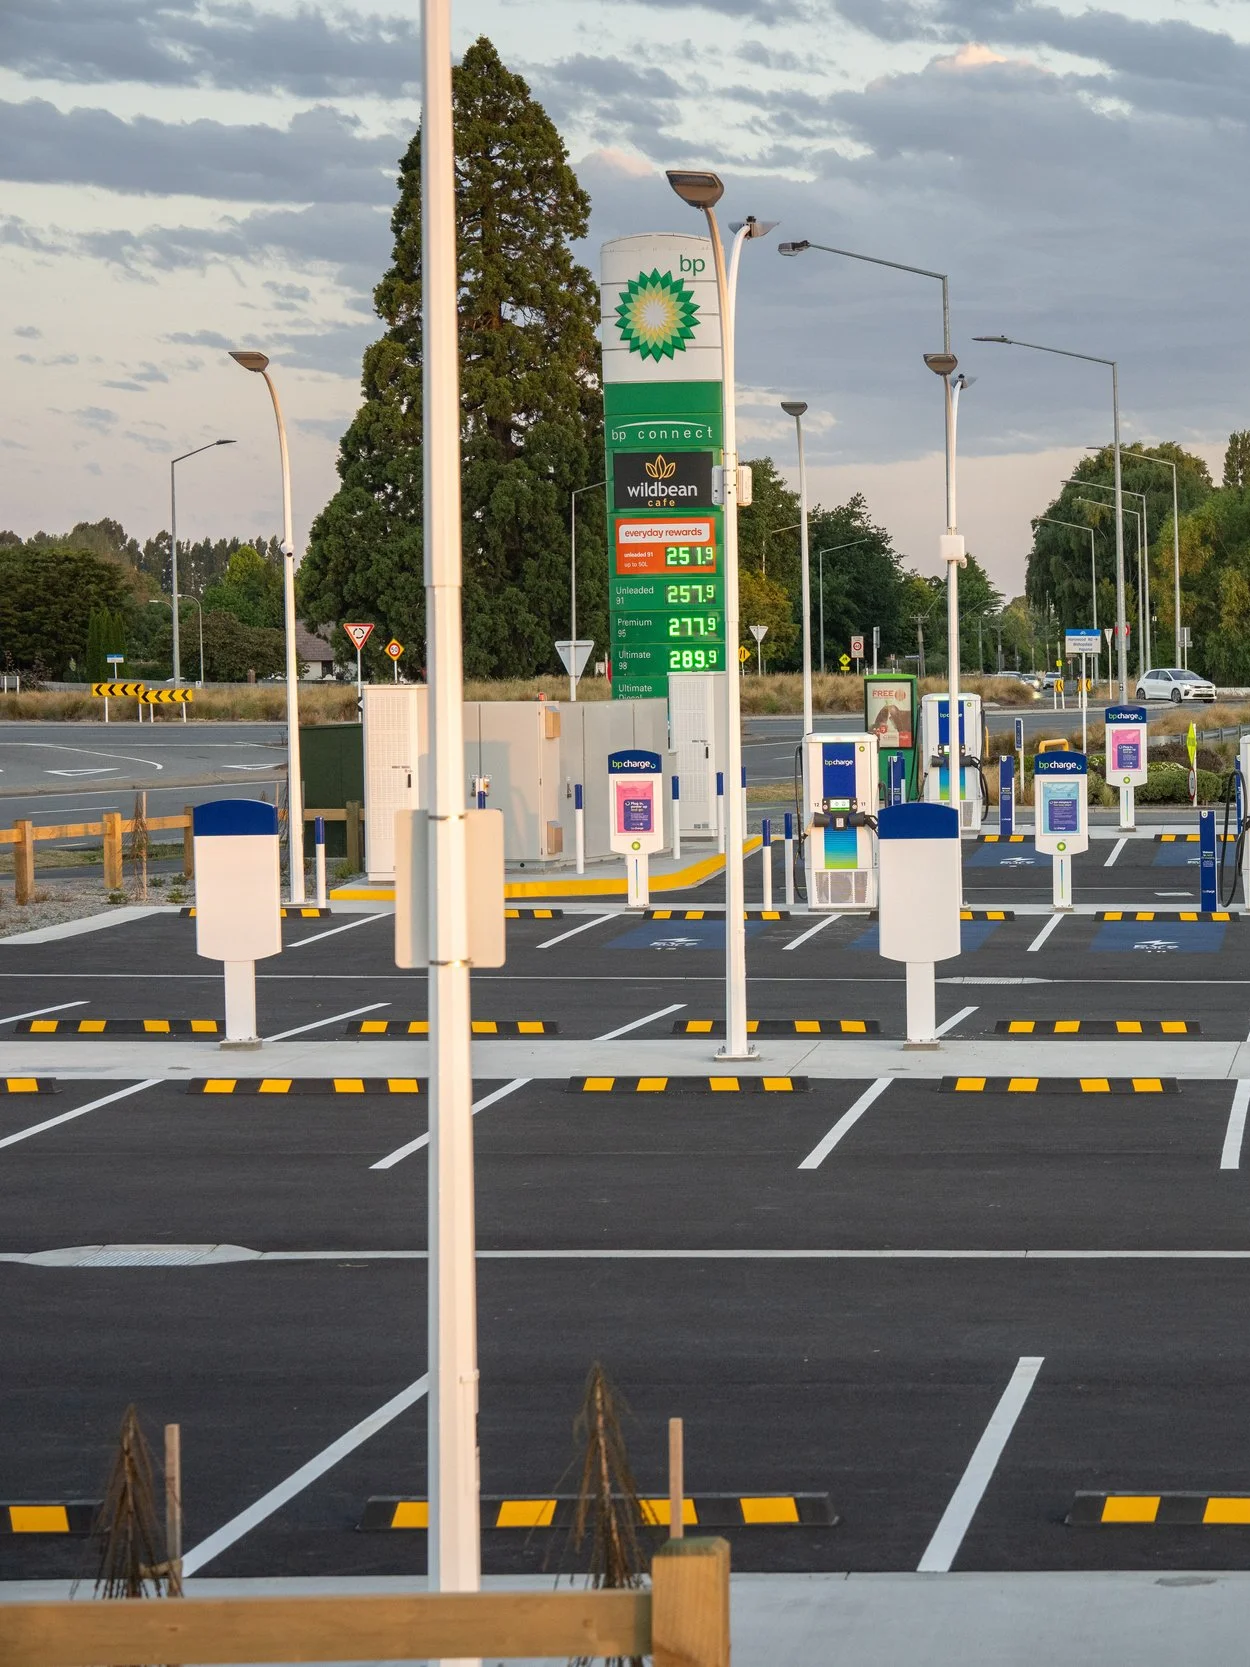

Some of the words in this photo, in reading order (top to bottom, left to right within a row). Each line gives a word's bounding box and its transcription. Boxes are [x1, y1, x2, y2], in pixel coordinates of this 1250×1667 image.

[680, 254, 706, 276] bp
[612, 429, 626, 442] bp
[638, 426, 712, 439] connect
[627, 482, 698, 497] wildbean
[648, 498, 676, 506] cafe
[624, 528, 664, 538] everyday
[666, 528, 702, 536] rewards
[616, 586, 654, 594] Unleaded
[619, 651, 651, 659] Ultimate
[619, 662, 628, 670] 98
[619, 684, 652, 692] Ultimate
